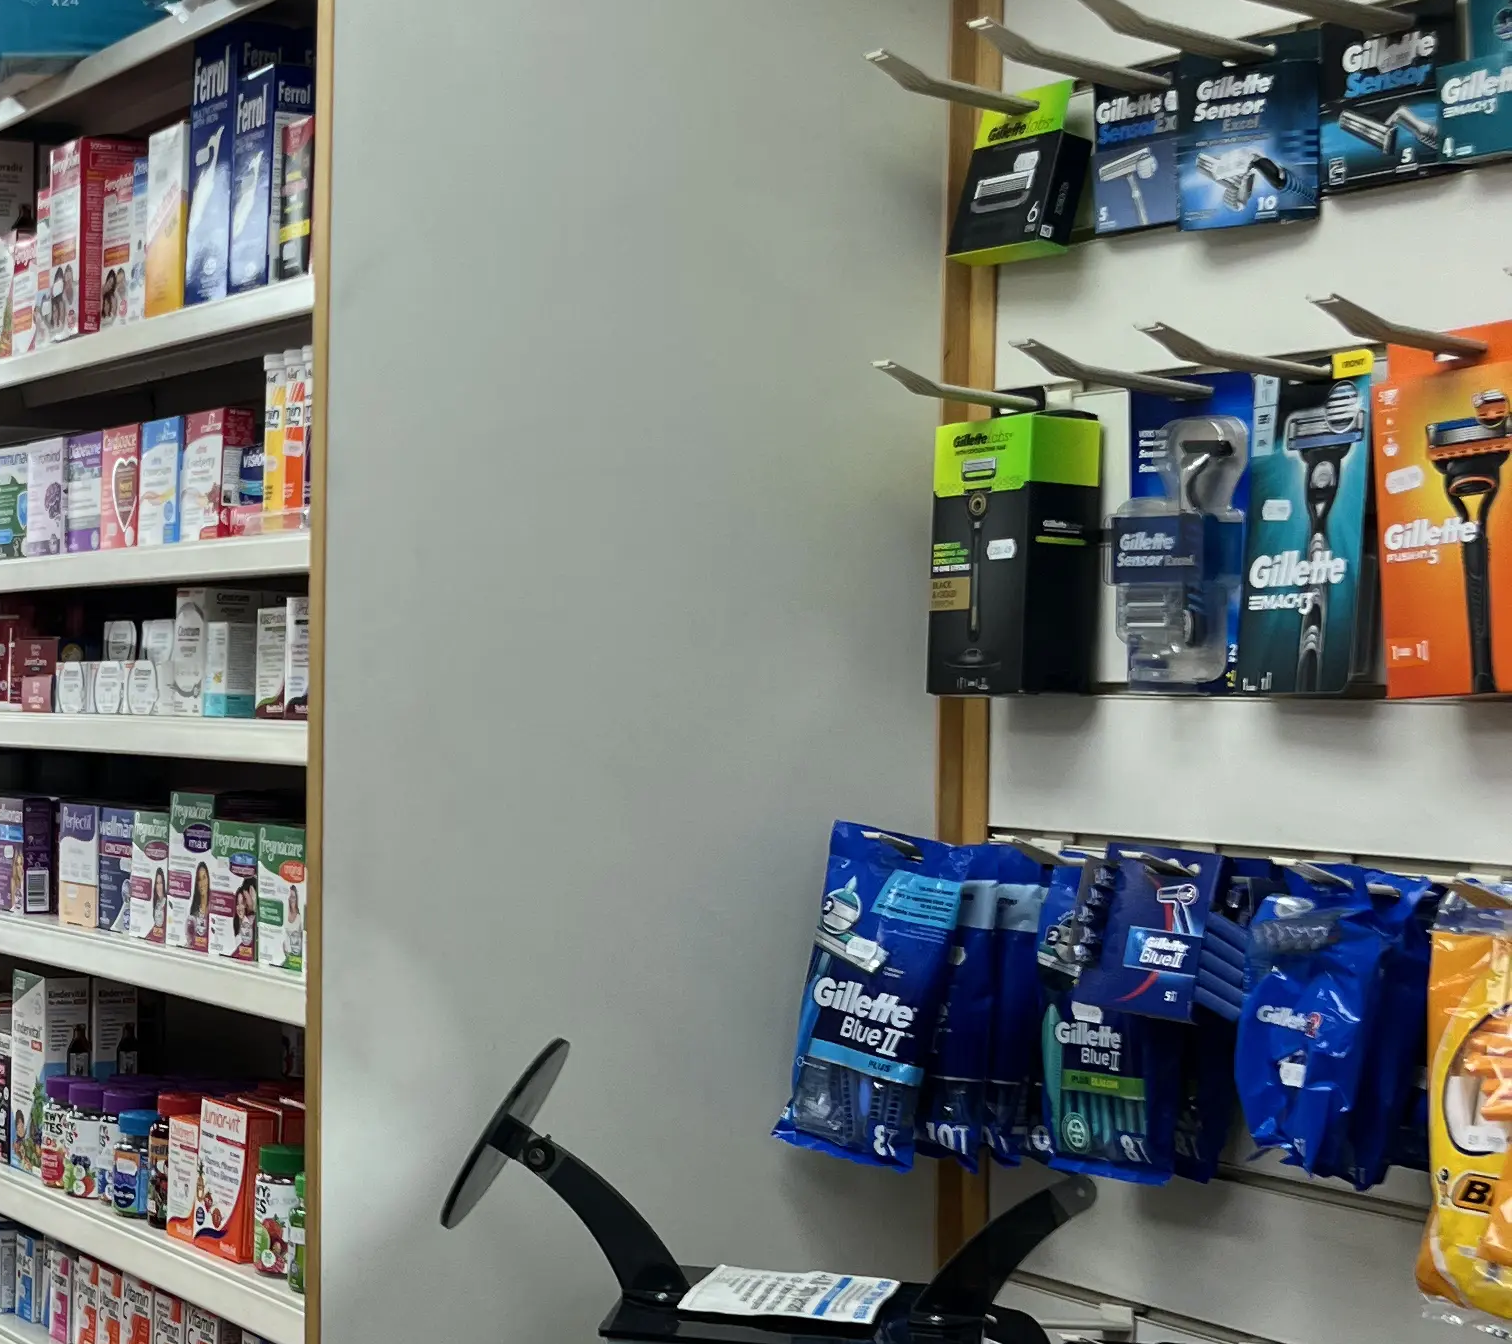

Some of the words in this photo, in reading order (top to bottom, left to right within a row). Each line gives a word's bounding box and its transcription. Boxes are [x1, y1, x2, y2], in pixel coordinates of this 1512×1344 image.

[193, 44, 231, 106] Ferrol
[1344, 64, 1432, 98] Sensor
[278, 80, 312, 105] Ferrol
[1196, 73, 1275, 102] Gillette
[236, 83, 269, 135] Ferrol
[1096, 93, 1162, 124] Gillette
[1194, 99, 1266, 123] Sensor
[1222, 115, 1260, 133] Excel
[1400, 147, 1414, 164] 5
[1443, 137, 1455, 158] 4
[1027, 200, 1039, 223] 6
[1098, 207, 1109, 222] 5
[1257, 196, 1278, 212] 10
[1119, 532, 1176, 554] Gillette
[1385, 517, 1479, 551] Gillette
[1116, 552, 1164, 568] Sensor
[1249, 551, 1348, 589] Gillette
[216, 592, 251, 605] Centrum
[177, 626, 201, 638] Centrum
[188, 840, 208, 850] max
[1146, 936, 1190, 953] Gillette
[1139, 949, 1172, 966] Blue
[48, 989, 87, 999] Kindervital
[813, 977, 916, 1029] Gillette
[840, 1016, 882, 1046] Blue
[1055, 1022, 1122, 1051] Gillette
[1080, 1047, 1110, 1067] Blue
[99, 1292, 120, 1310] Vitamin
[123, 1277, 150, 1306] Vitamin
[155, 1316, 180, 1338] Vitamin
[187, 1307, 216, 1332] Vitamin
